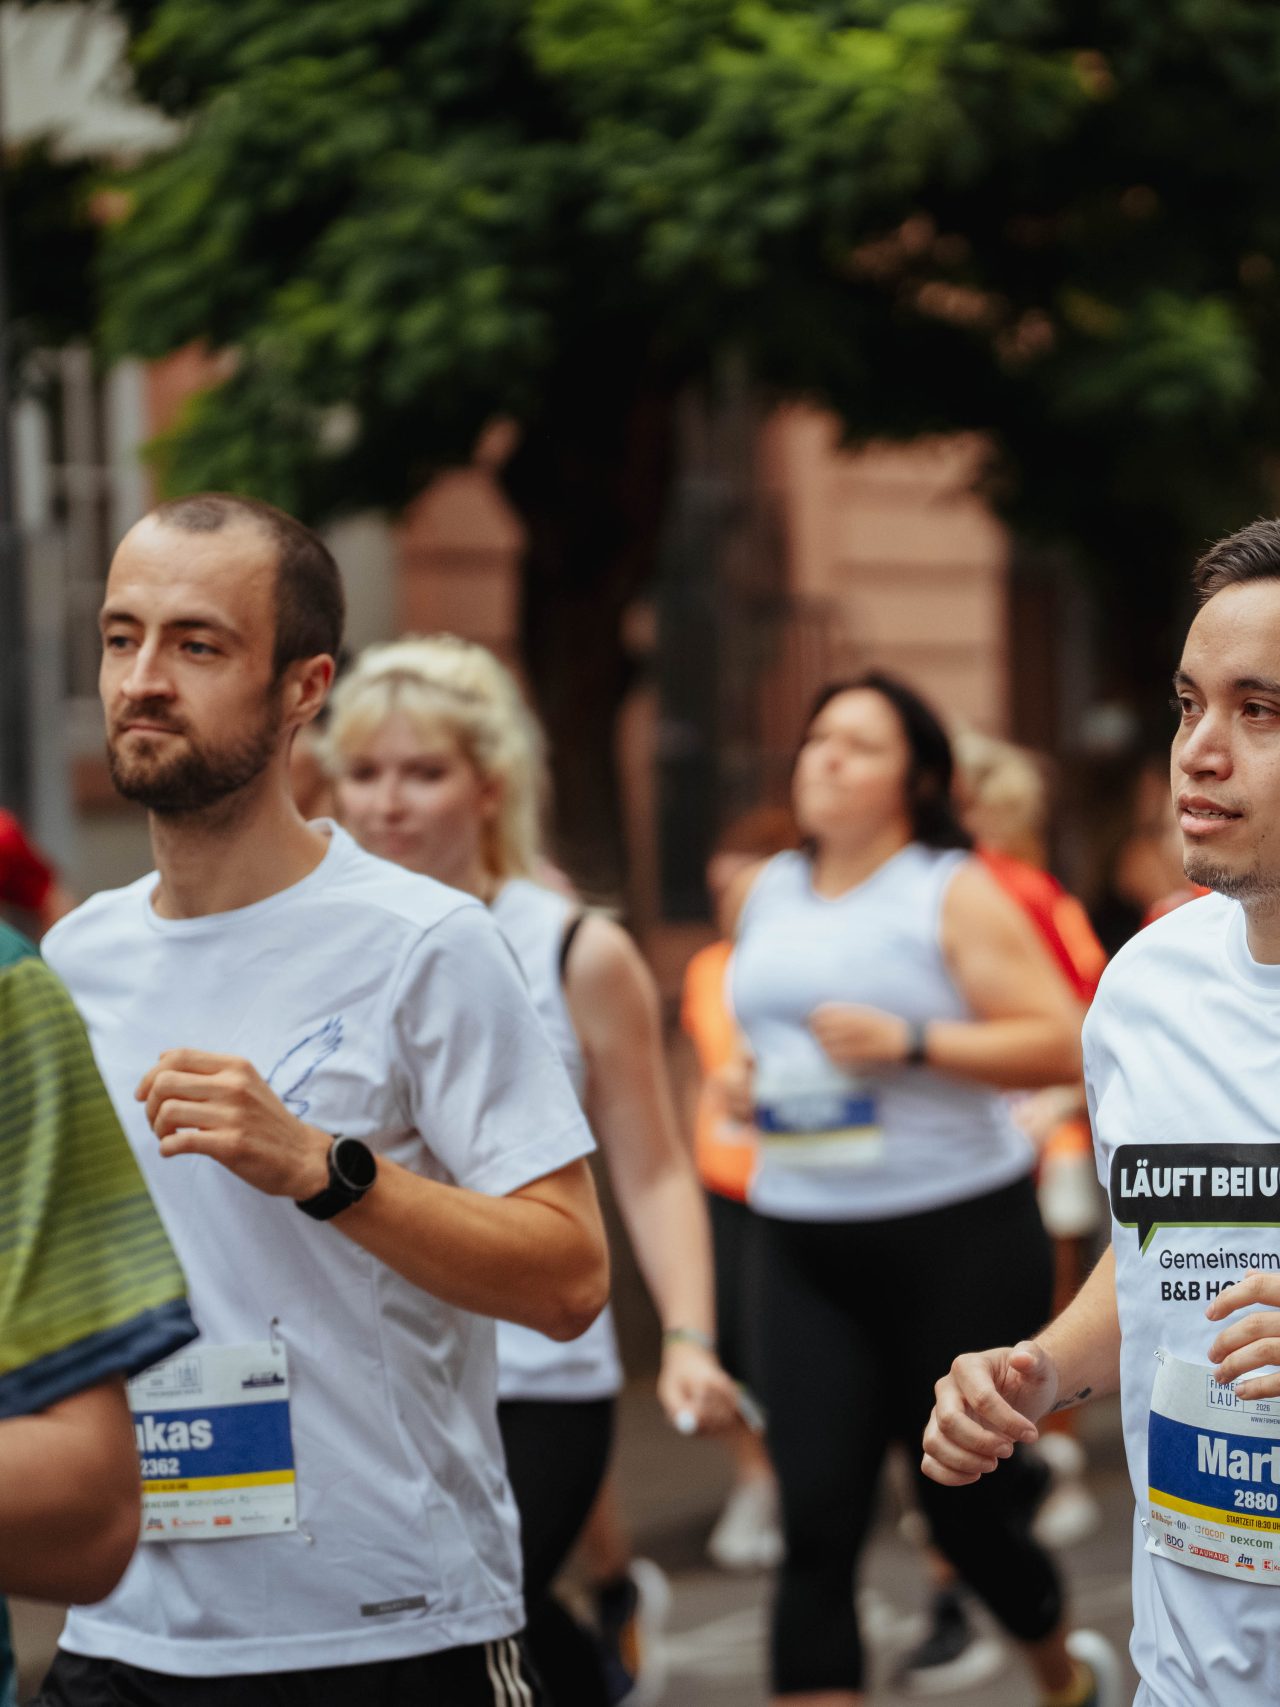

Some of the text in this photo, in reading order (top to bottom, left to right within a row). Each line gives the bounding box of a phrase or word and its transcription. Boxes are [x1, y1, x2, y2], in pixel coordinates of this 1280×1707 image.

[1120, 1159, 1207, 1198] LÄUFT
[1211, 1167, 1253, 1198] BEI
[1159, 1249, 1280, 1270] Gemeinsam
[1161, 1281, 1200, 1301] B&B
[1210, 1380, 1241, 1392] FIRME
[140, 1457, 181, 1478] 2362
[1233, 1489, 1278, 1512] 2880
[1226, 1514, 1255, 1528] STARTZEIT
[1166, 1533, 1184, 1549] BDO
[1194, 1546, 1229, 1563] BAUHAUS
[1237, 1553, 1253, 1565] dm
